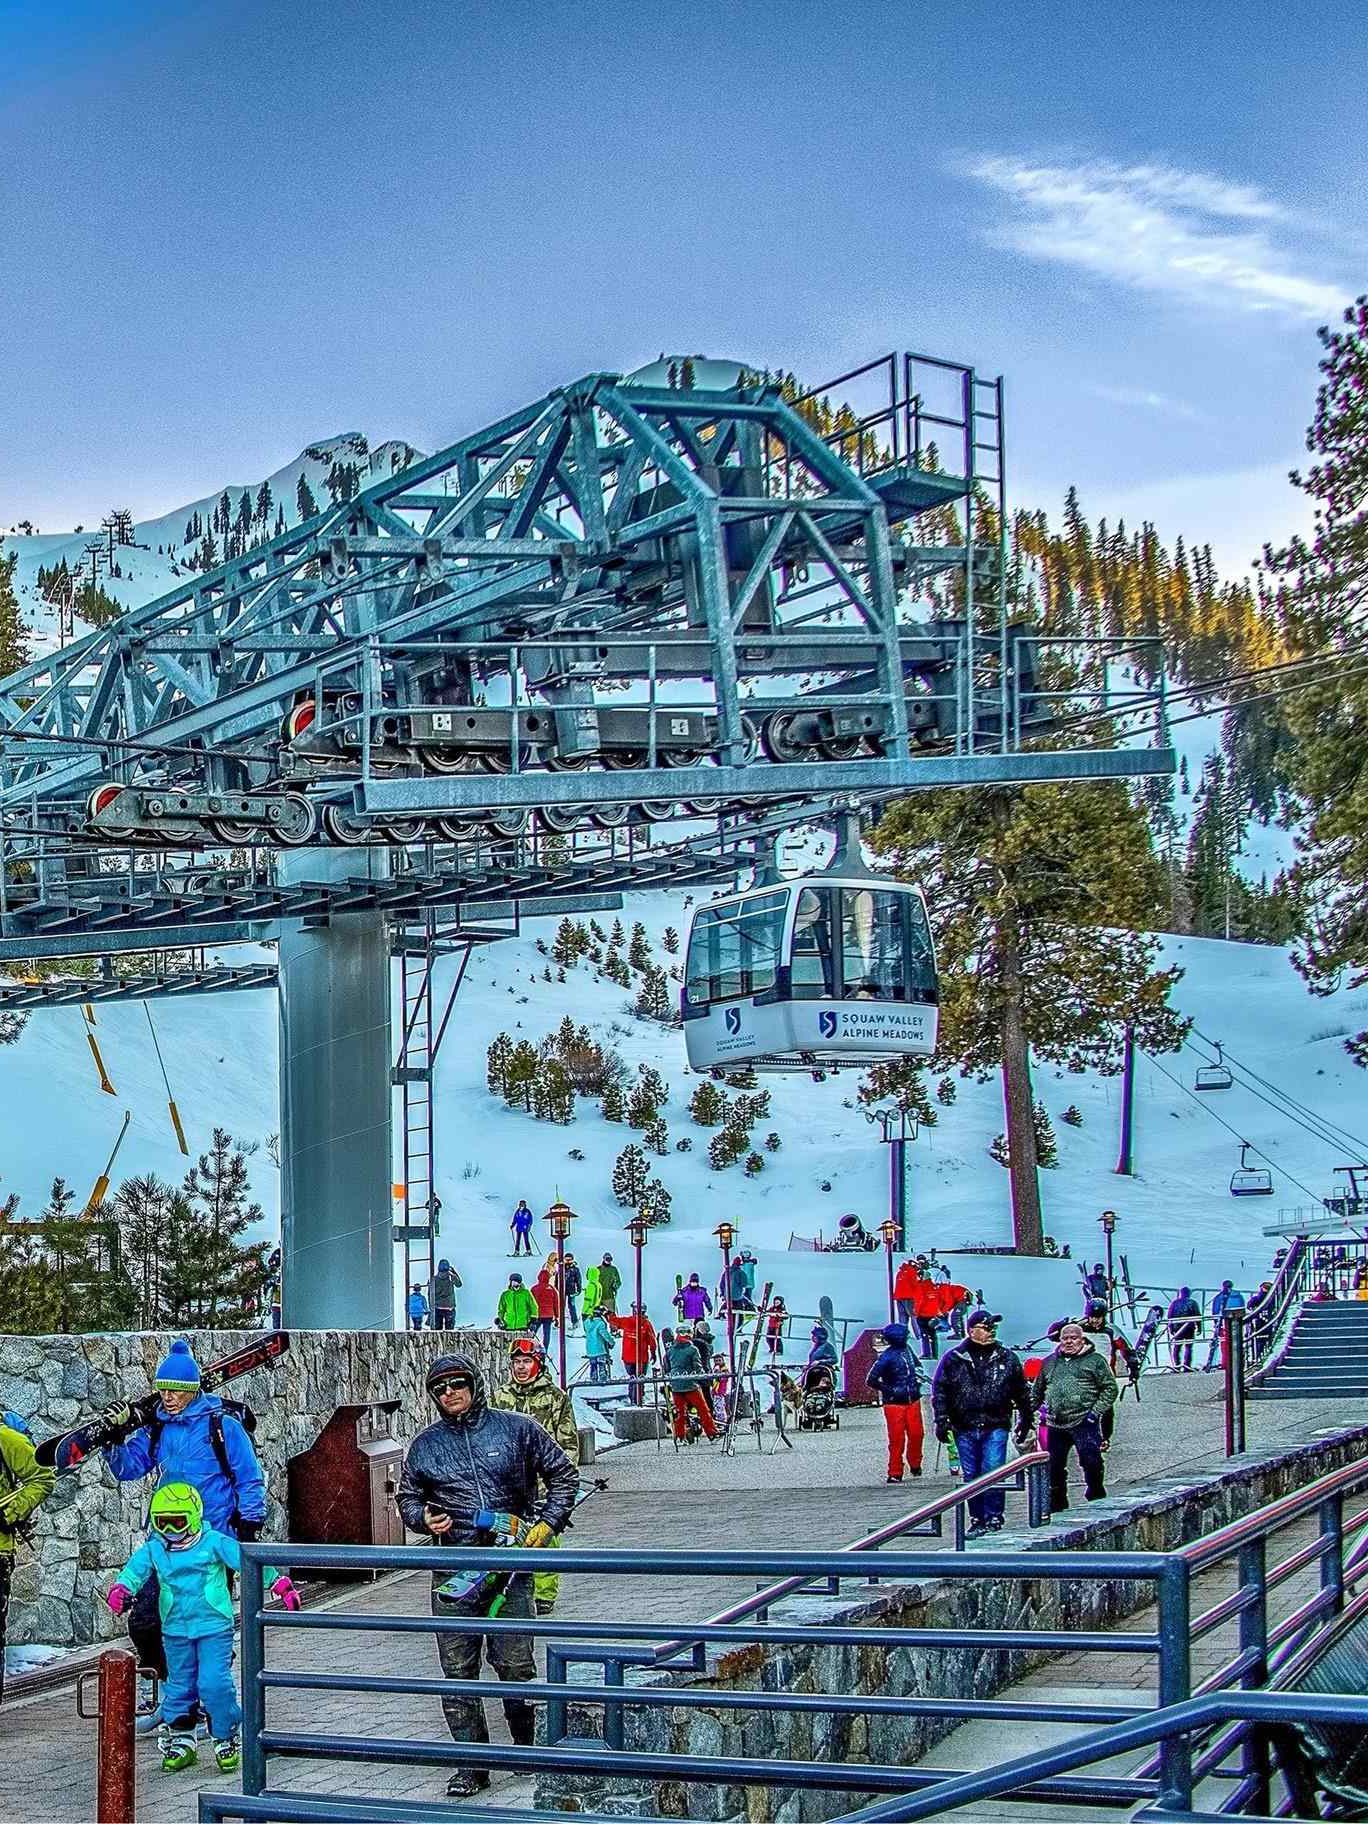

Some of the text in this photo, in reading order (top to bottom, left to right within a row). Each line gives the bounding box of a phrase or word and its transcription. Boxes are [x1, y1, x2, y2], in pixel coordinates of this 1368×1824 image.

[842, 1014, 923, 1026] SQUAW VALLEY
[842, 1028, 924, 1040] ALPINE MEADOWS
